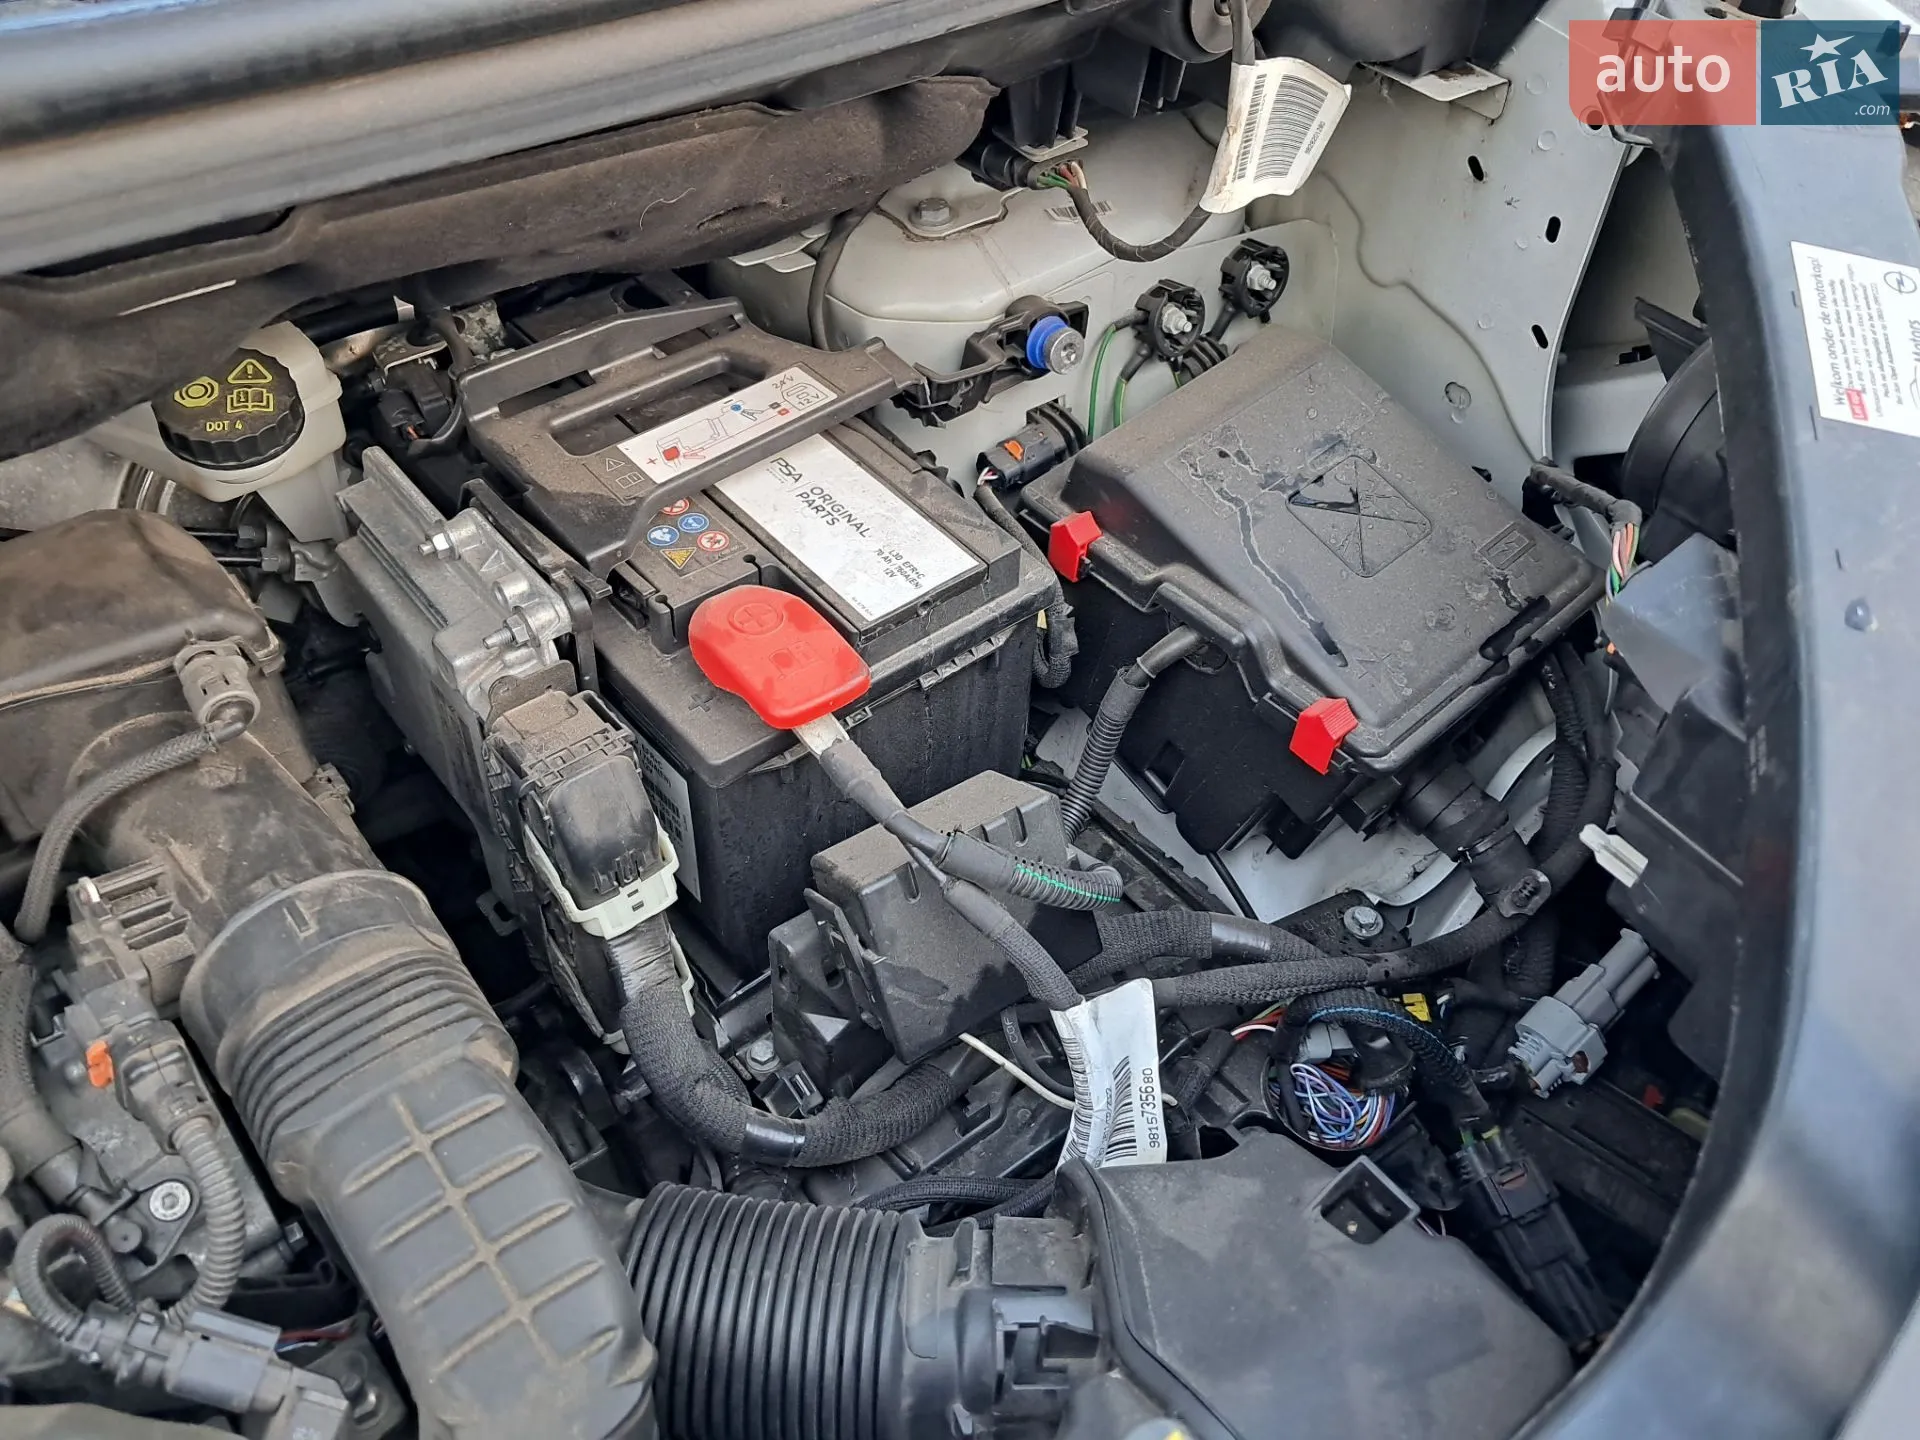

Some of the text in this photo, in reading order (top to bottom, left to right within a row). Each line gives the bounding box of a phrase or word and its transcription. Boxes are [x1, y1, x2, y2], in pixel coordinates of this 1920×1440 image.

[1807, 256, 1846, 405] Welkom onder de motorkap!
[206, 420, 243, 432] DOT 4
[769, 457, 803, 483] PSA
[795, 491, 840, 526] PARTS
[810, 486, 870, 538] ORIGINAL
[880, 555, 892, 564] Ah
[883, 568, 897, 577] 12V
[1138, 1067, 1160, 1149] 9815735680
